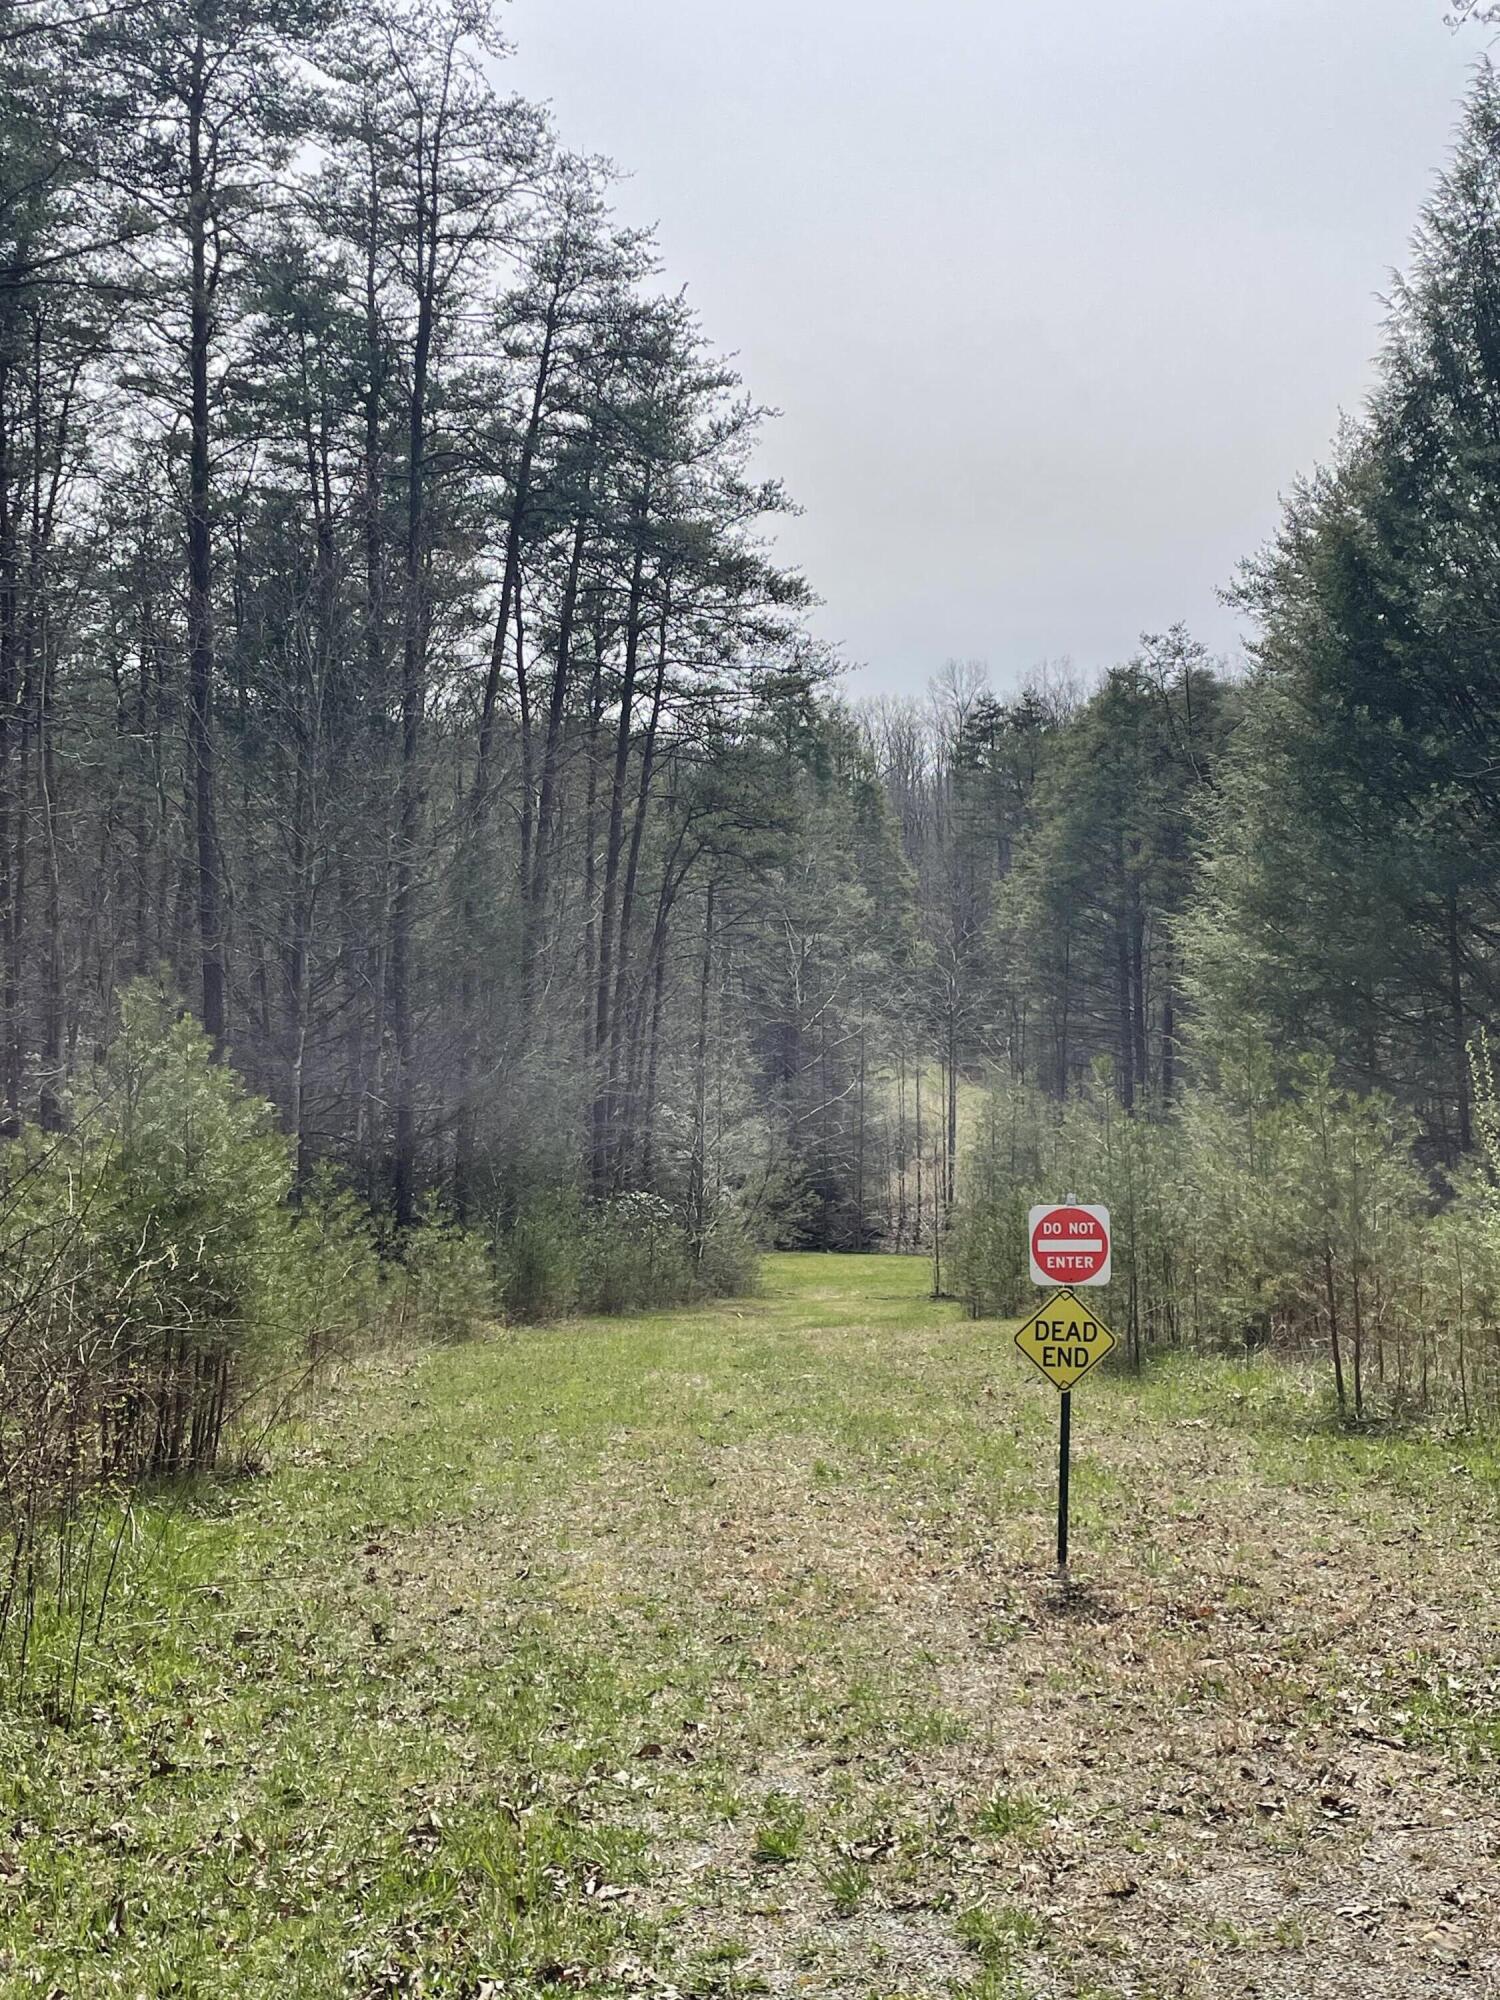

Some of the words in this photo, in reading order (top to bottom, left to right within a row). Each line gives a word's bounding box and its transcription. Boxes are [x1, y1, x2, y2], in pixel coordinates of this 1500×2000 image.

[1043, 1222, 1062, 1235] DO
[1068, 1222, 1095, 1235] NOT
[1046, 1256, 1094, 1269] ENTER
[1035, 1320, 1098, 1343] DEAD
[1042, 1346, 1089, 1368] END
